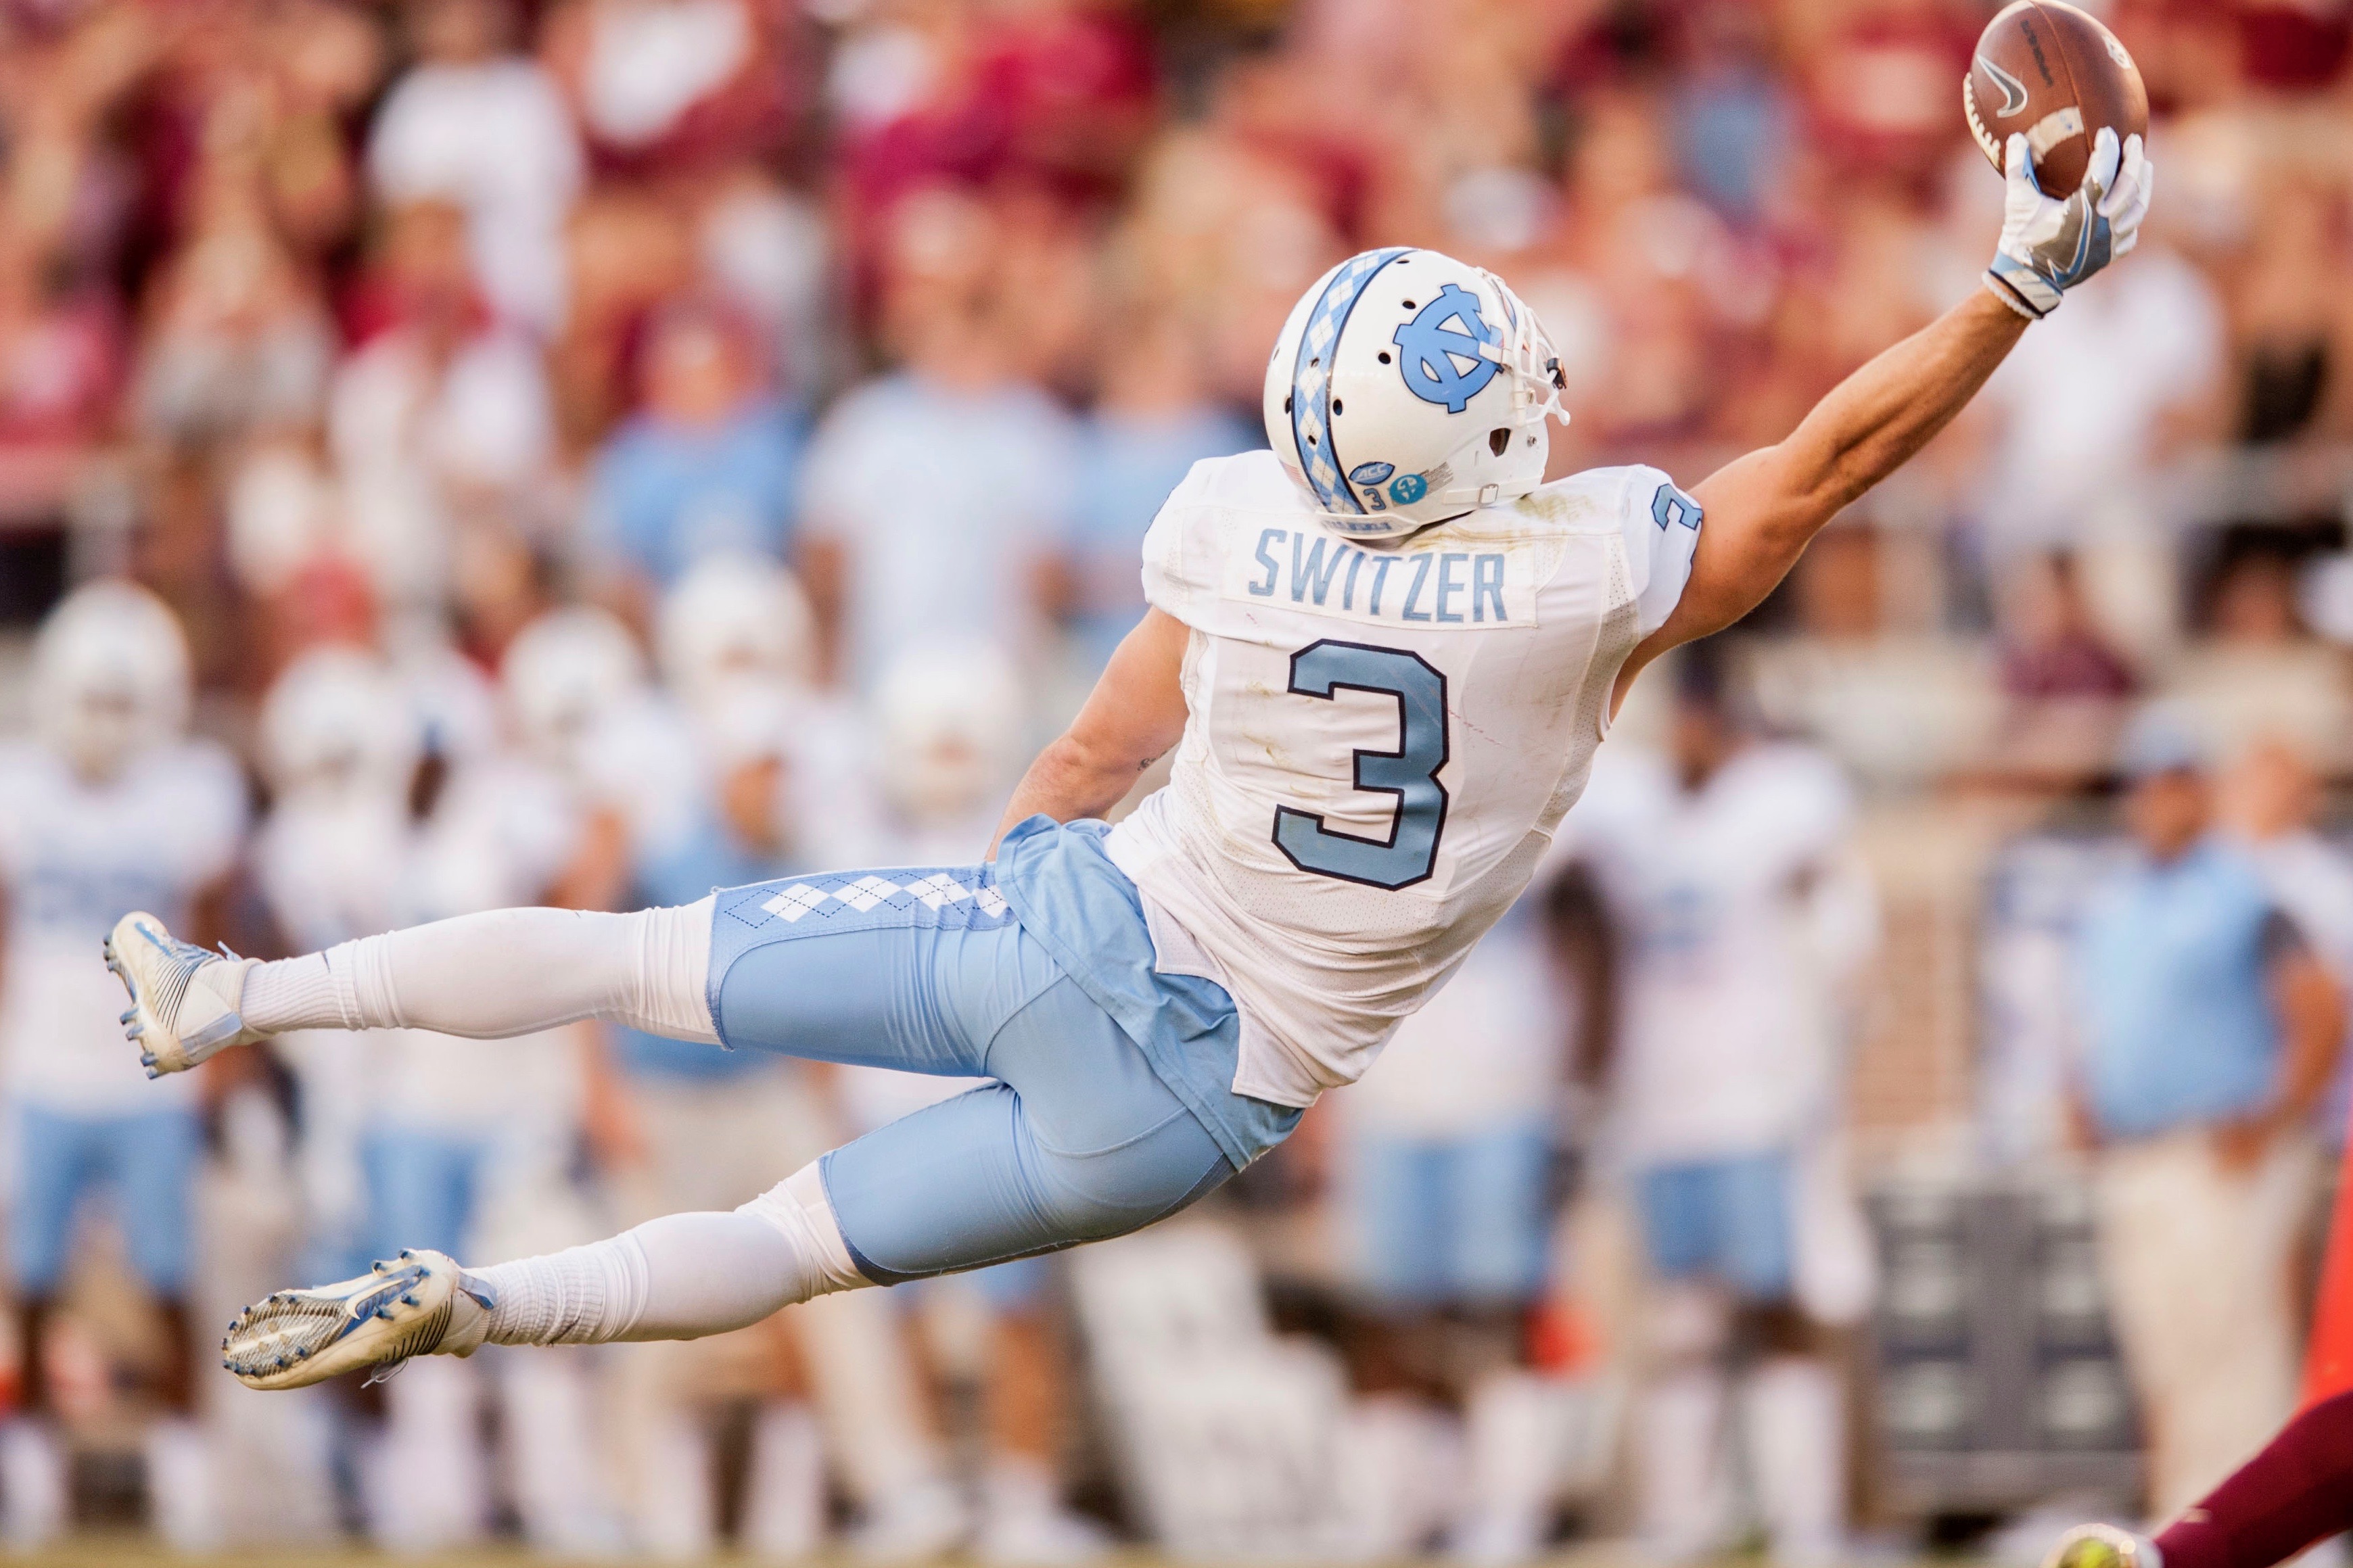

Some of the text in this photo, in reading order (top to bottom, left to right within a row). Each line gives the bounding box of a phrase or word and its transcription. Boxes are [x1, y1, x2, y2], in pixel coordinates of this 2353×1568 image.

[1354, 462, 1388, 481] ACC
[1363, 488, 1387, 510] 3
[1249, 528, 1507, 622] SWITZER
[1272, 638, 1447, 891] 3
